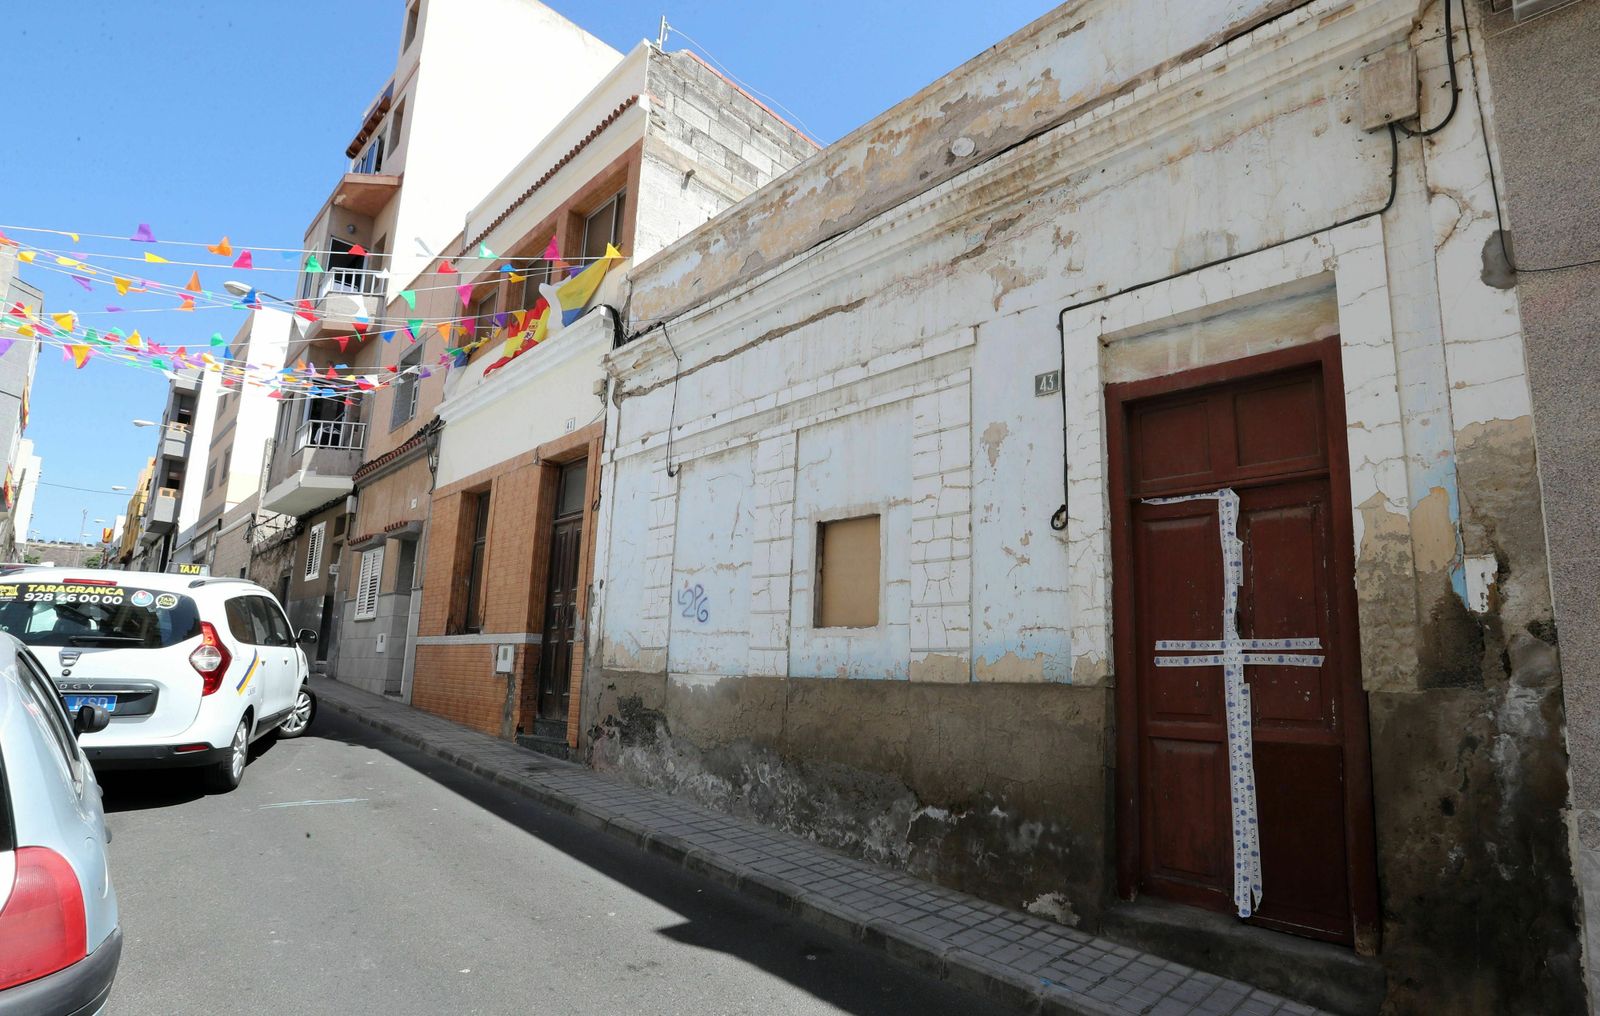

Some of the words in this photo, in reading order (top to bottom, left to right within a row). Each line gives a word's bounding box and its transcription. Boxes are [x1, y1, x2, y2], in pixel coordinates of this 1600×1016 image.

[1040, 374, 1054, 391] 43
[180, 564, 200, 574] TAXI
[27, 584, 124, 596] TARAGRANCA
[24, 592, 54, 601] 928
[56, 593, 77, 603] 46
[79, 594, 100, 603] 00
[102, 595, 123, 605] 00
